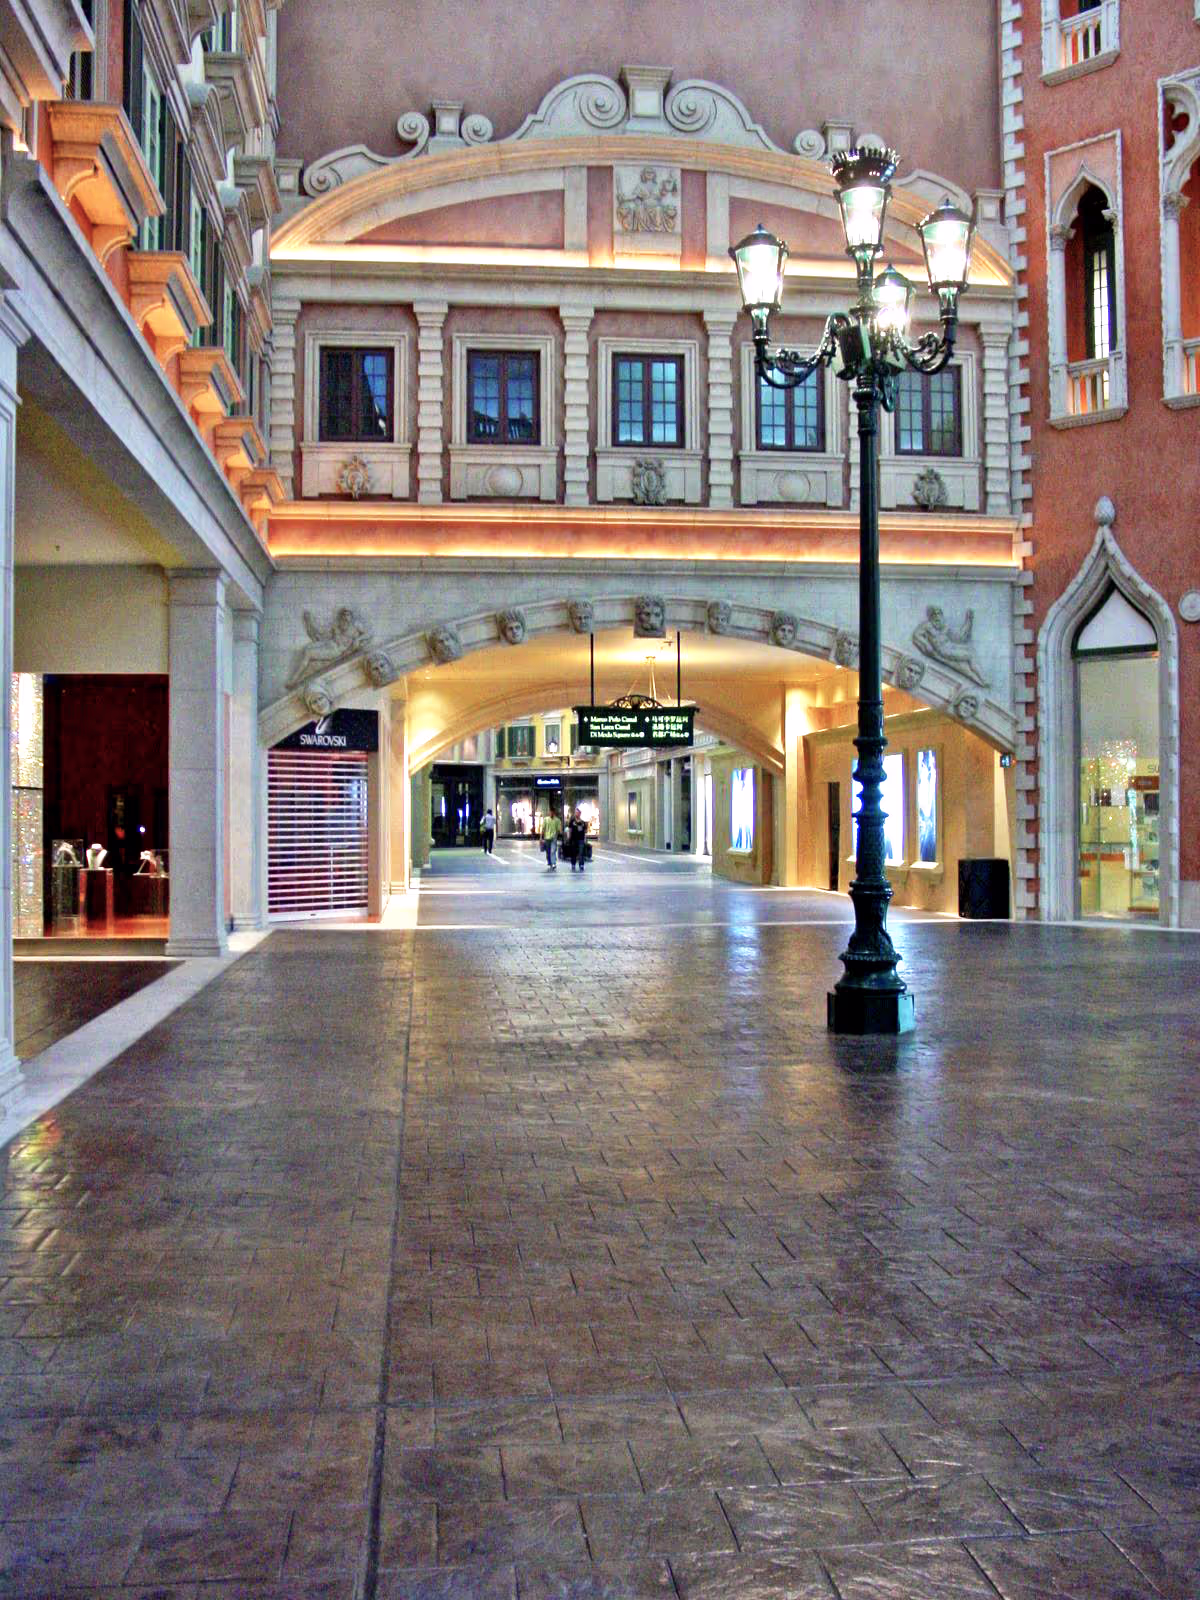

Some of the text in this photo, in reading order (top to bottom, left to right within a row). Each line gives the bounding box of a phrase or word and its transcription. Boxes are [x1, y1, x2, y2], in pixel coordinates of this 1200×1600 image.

[608, 715, 621, 723] Polo
[621, 715, 638, 723] Canal
[300, 734, 347, 747] SWAROVSKI
